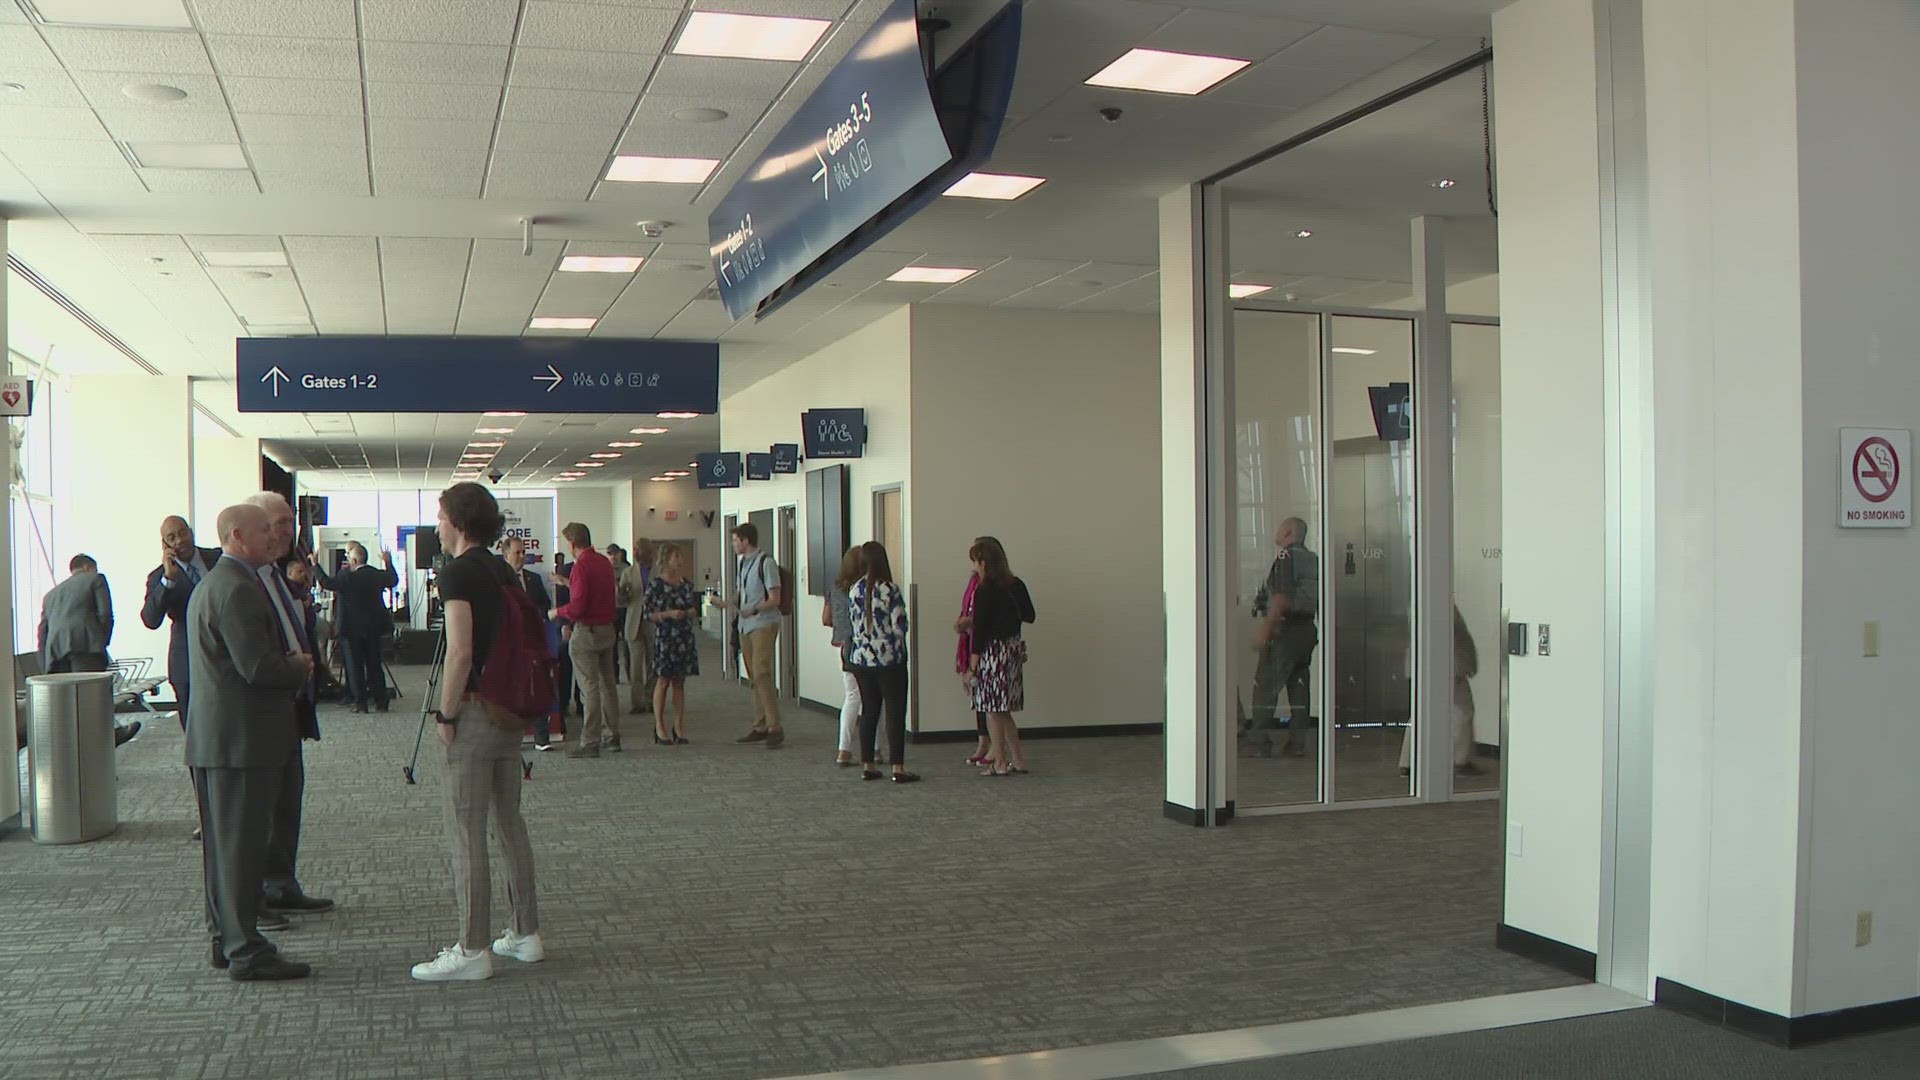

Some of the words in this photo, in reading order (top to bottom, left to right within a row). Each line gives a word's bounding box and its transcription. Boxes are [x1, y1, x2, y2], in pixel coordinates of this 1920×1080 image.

[826, 117, 853, 156] Gates
[850, 91, 871, 133] 3-5
[3, 382, 20, 390] AED
[301, 374, 347, 389] Gates
[349, 374, 378, 389] 1-2
[1847, 511, 1861, 520] NO
[1862, 511, 1905, 520] SMOKING
